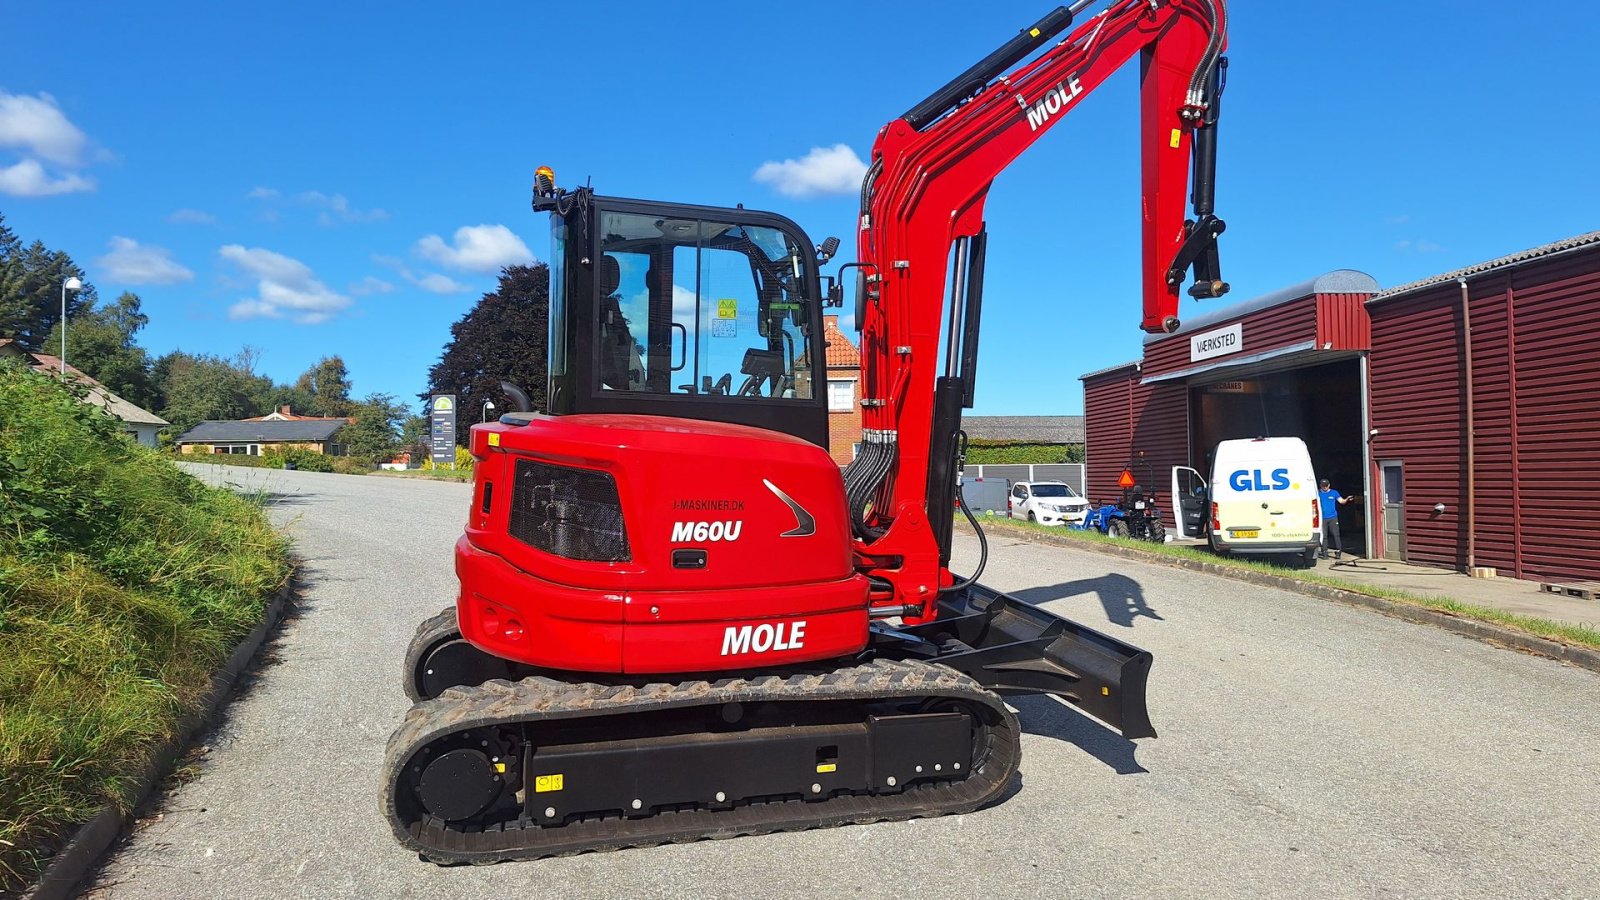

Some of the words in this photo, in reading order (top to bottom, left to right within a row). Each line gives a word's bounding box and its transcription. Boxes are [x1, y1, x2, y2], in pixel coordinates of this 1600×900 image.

[1026, 71, 1083, 132] MOLE
[1196, 332, 1236, 354] VÆRKSTED
[673, 499, 745, 511] J-MASKINER.DK
[671, 520, 743, 542] M60U
[720, 620, 806, 656] MOLE
